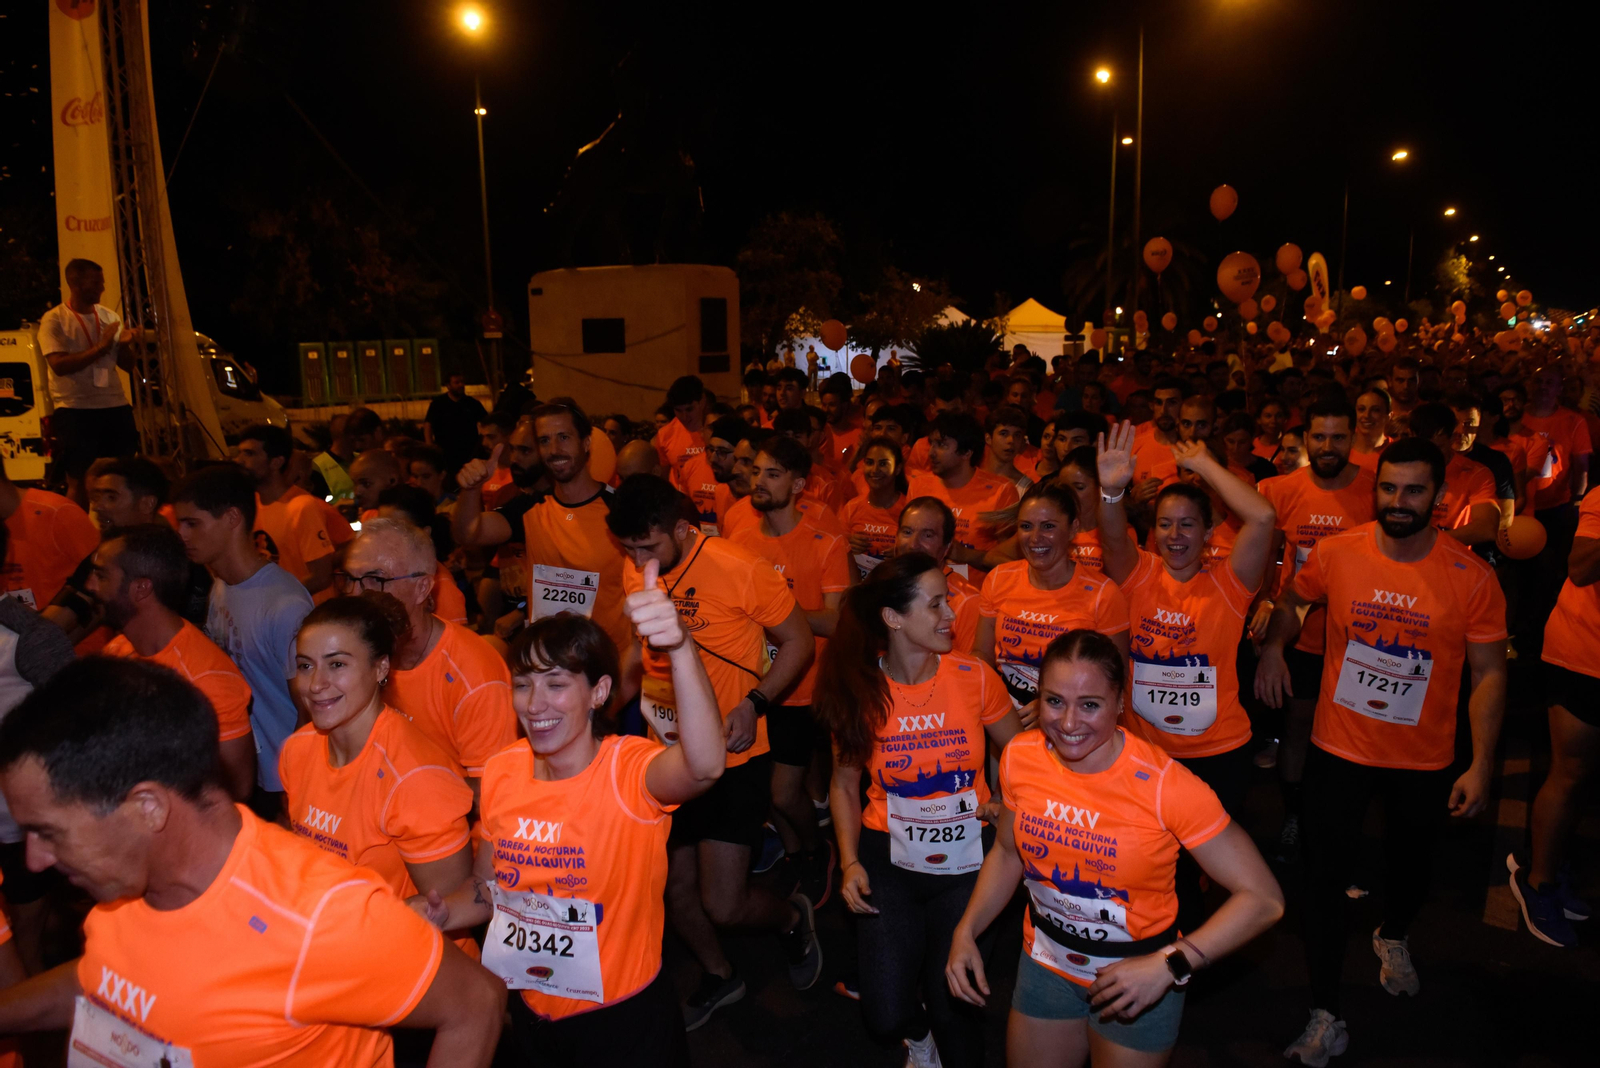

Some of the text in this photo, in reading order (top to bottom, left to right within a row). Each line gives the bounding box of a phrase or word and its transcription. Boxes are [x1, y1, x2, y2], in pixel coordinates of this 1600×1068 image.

[701, 483, 716, 492] XXX
[864, 523, 889, 533] XXXV
[1309, 514, 1343, 526] XXXV
[542, 588, 586, 604] 22260
[1372, 589, 1418, 609] XXXV
[1017, 610, 1059, 623] XXXV
[1154, 608, 1190, 626] XXXV
[1352, 600, 1430, 620] CARRERA NOCTURNA
[1356, 608, 1429, 628] GUADALQUIVIR
[1003, 616, 1069, 632] CARRERA NOCTURNA
[1005, 624, 1060, 639] GUADALQUIV
[1357, 670, 1413, 696] 17217
[1148, 689, 1200, 707] 17219
[897, 712, 946, 733] XXXV
[921, 728, 966, 739] NOCTURNA
[886, 736, 968, 752] GUADALQUIVIR
[304, 805, 342, 835] XXXV
[1043, 799, 1100, 830] XXXV
[514, 817, 564, 843] XXXV
[905, 824, 966, 843] 17282
[1022, 812, 1118, 846] CARRERA NOCTURNA
[314, 833, 348, 851] NOCTURNA
[534, 845, 584, 855] NOCTURNA
[1024, 824, 1117, 858] GUADALQUIVIR
[497, 850, 586, 869] GUADALQUIVIR
[503, 922, 574, 958] 20342
[97, 965, 157, 1023] XXXV
[566, 987, 598, 996] Cruzcampo
